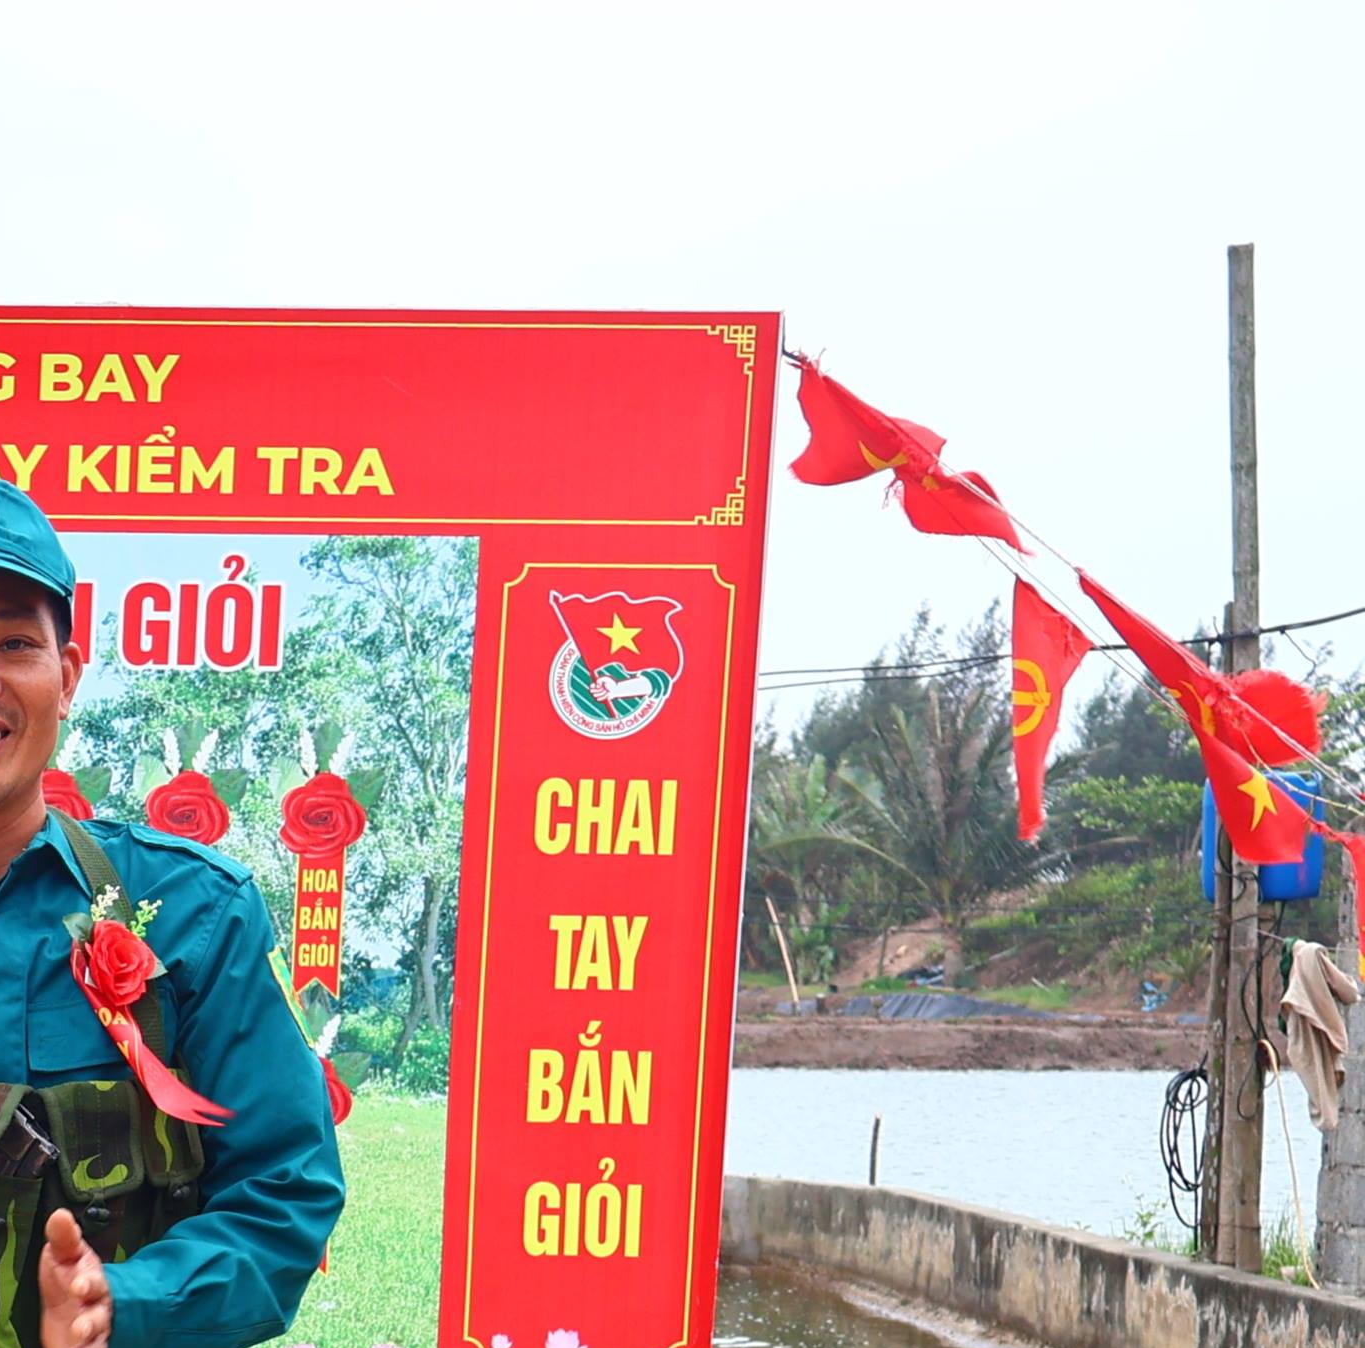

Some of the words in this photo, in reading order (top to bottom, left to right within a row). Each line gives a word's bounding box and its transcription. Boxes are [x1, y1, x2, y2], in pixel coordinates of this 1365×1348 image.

[39, 353, 180, 403] BAY
[67, 425, 236, 494] KIỂM
[256, 446, 394, 496] TRA
[122, 555, 281, 667] GIỎI
[534, 777, 678, 856] CHAI
[298, 897, 338, 930] BẮN
[301, 868, 339, 893] HOA
[298, 935, 336, 967] GIỎI
[549, 914, 649, 991] TAY
[526, 1020, 653, 1125] BẮN
[523, 1157, 643, 1258] GIỎI
